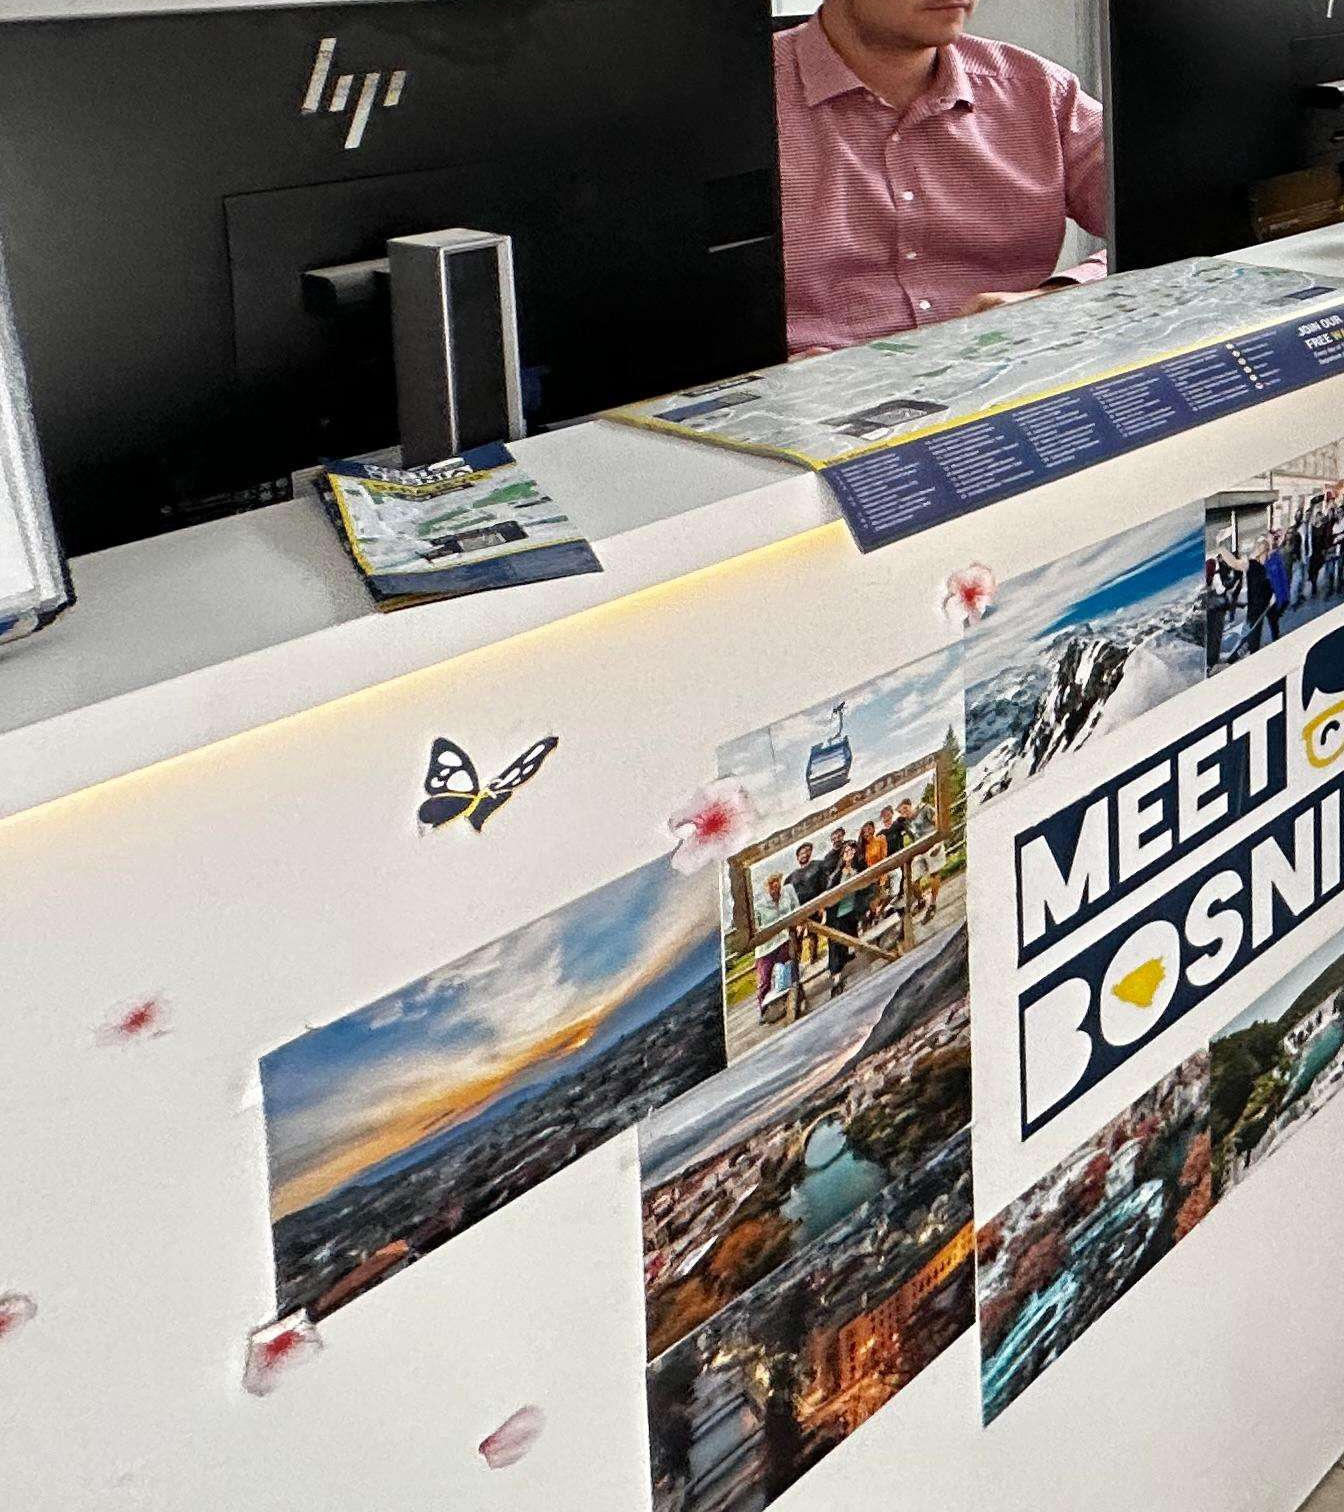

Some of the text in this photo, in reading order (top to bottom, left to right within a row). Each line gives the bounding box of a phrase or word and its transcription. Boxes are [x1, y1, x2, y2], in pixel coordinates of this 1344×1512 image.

[1297, 314, 1344, 337] JOIN OUR
[1304, 332, 1334, 349] FREE
[1020, 690, 1286, 948] MEET
